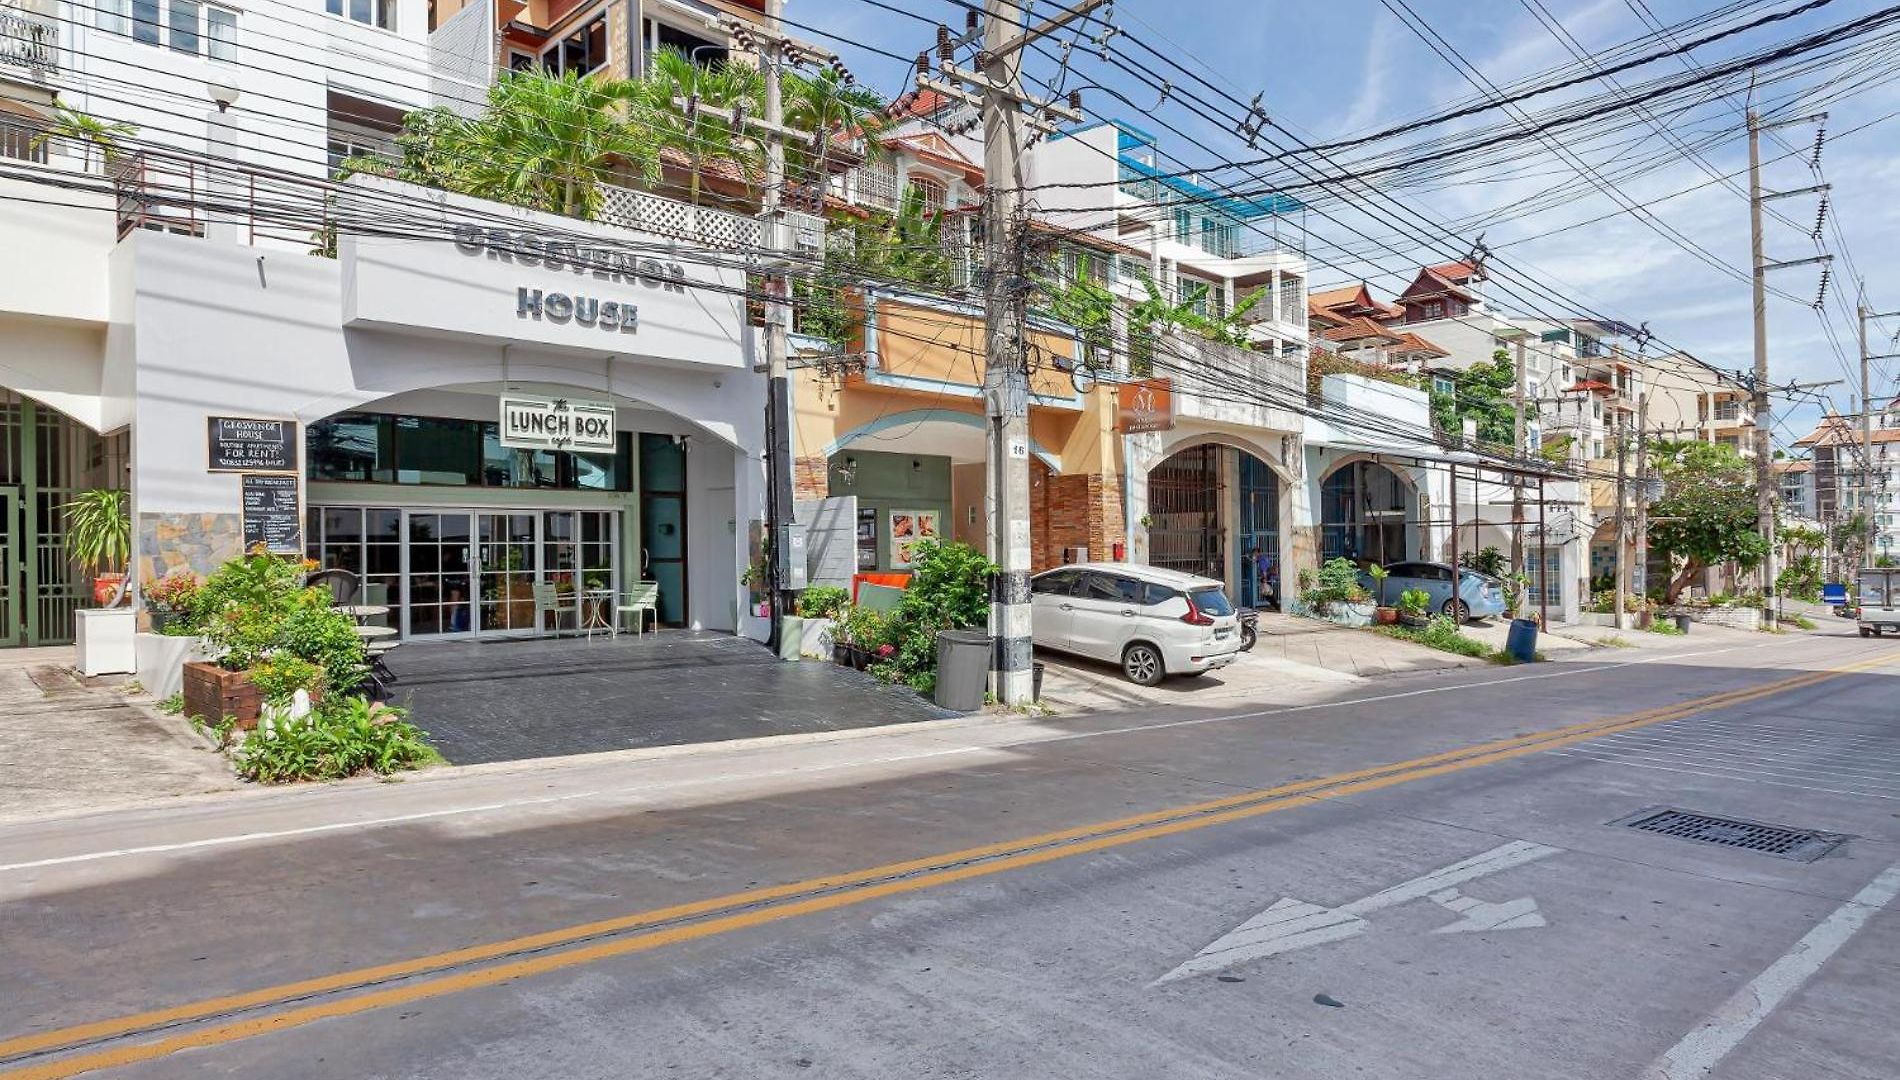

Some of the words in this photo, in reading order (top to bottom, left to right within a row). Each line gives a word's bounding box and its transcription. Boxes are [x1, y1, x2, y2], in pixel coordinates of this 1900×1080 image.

[517, 286, 638, 333] HOUSE
[511, 411, 570, 435] LUNCH
[575, 416, 609, 439] BOX
[236, 430, 264, 440] HOUSE
[225, 449, 245, 458] FOR
[1014, 445, 1025, 455] 16
